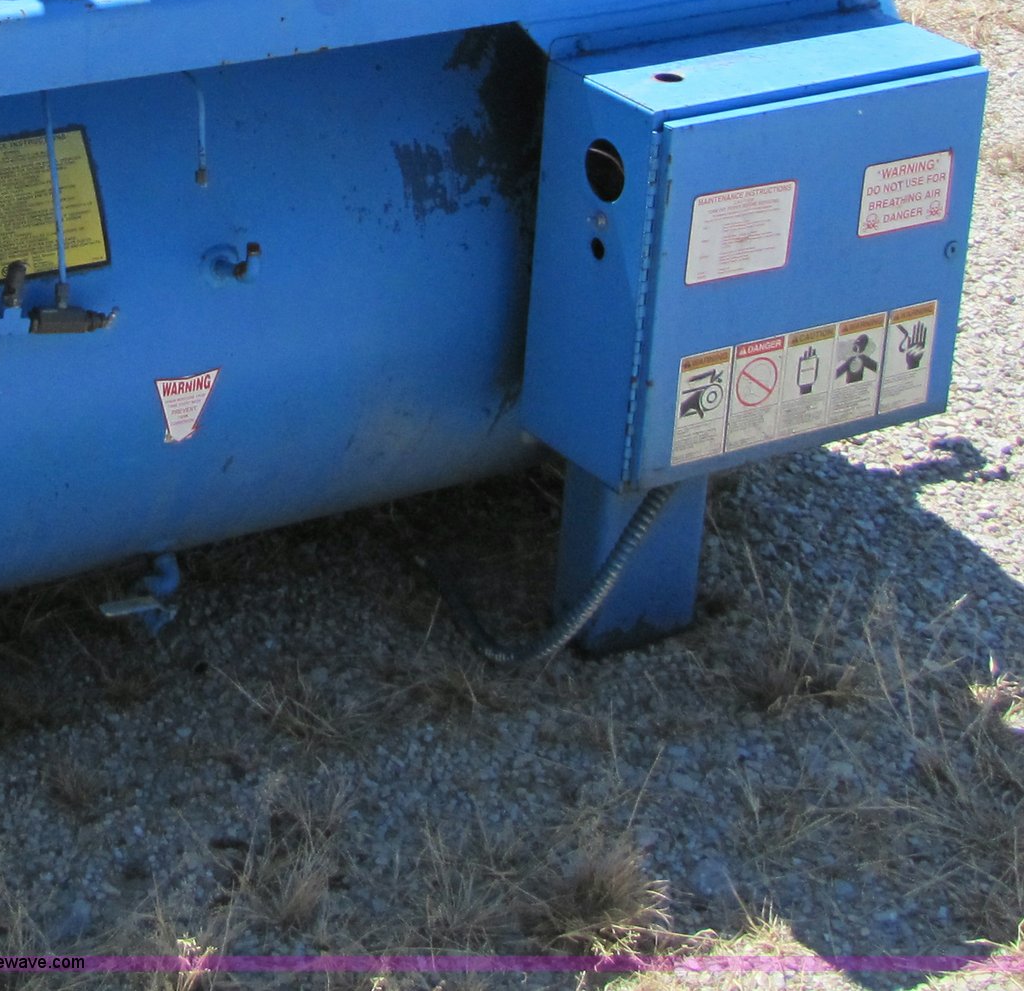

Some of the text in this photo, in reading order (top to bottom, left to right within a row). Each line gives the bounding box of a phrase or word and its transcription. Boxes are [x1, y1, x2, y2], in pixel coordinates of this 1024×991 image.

[697, 184, 792, 206] MAINTENANCE INSTRUCTIONS
[866, 172, 946, 196] DO NOT USE FOR
[868, 188, 941, 211] BREATHING AIR
[882, 207, 923, 224] DANGER
[747, 339, 782, 354] DANGER
[162, 374, 211, 397] WARNING
